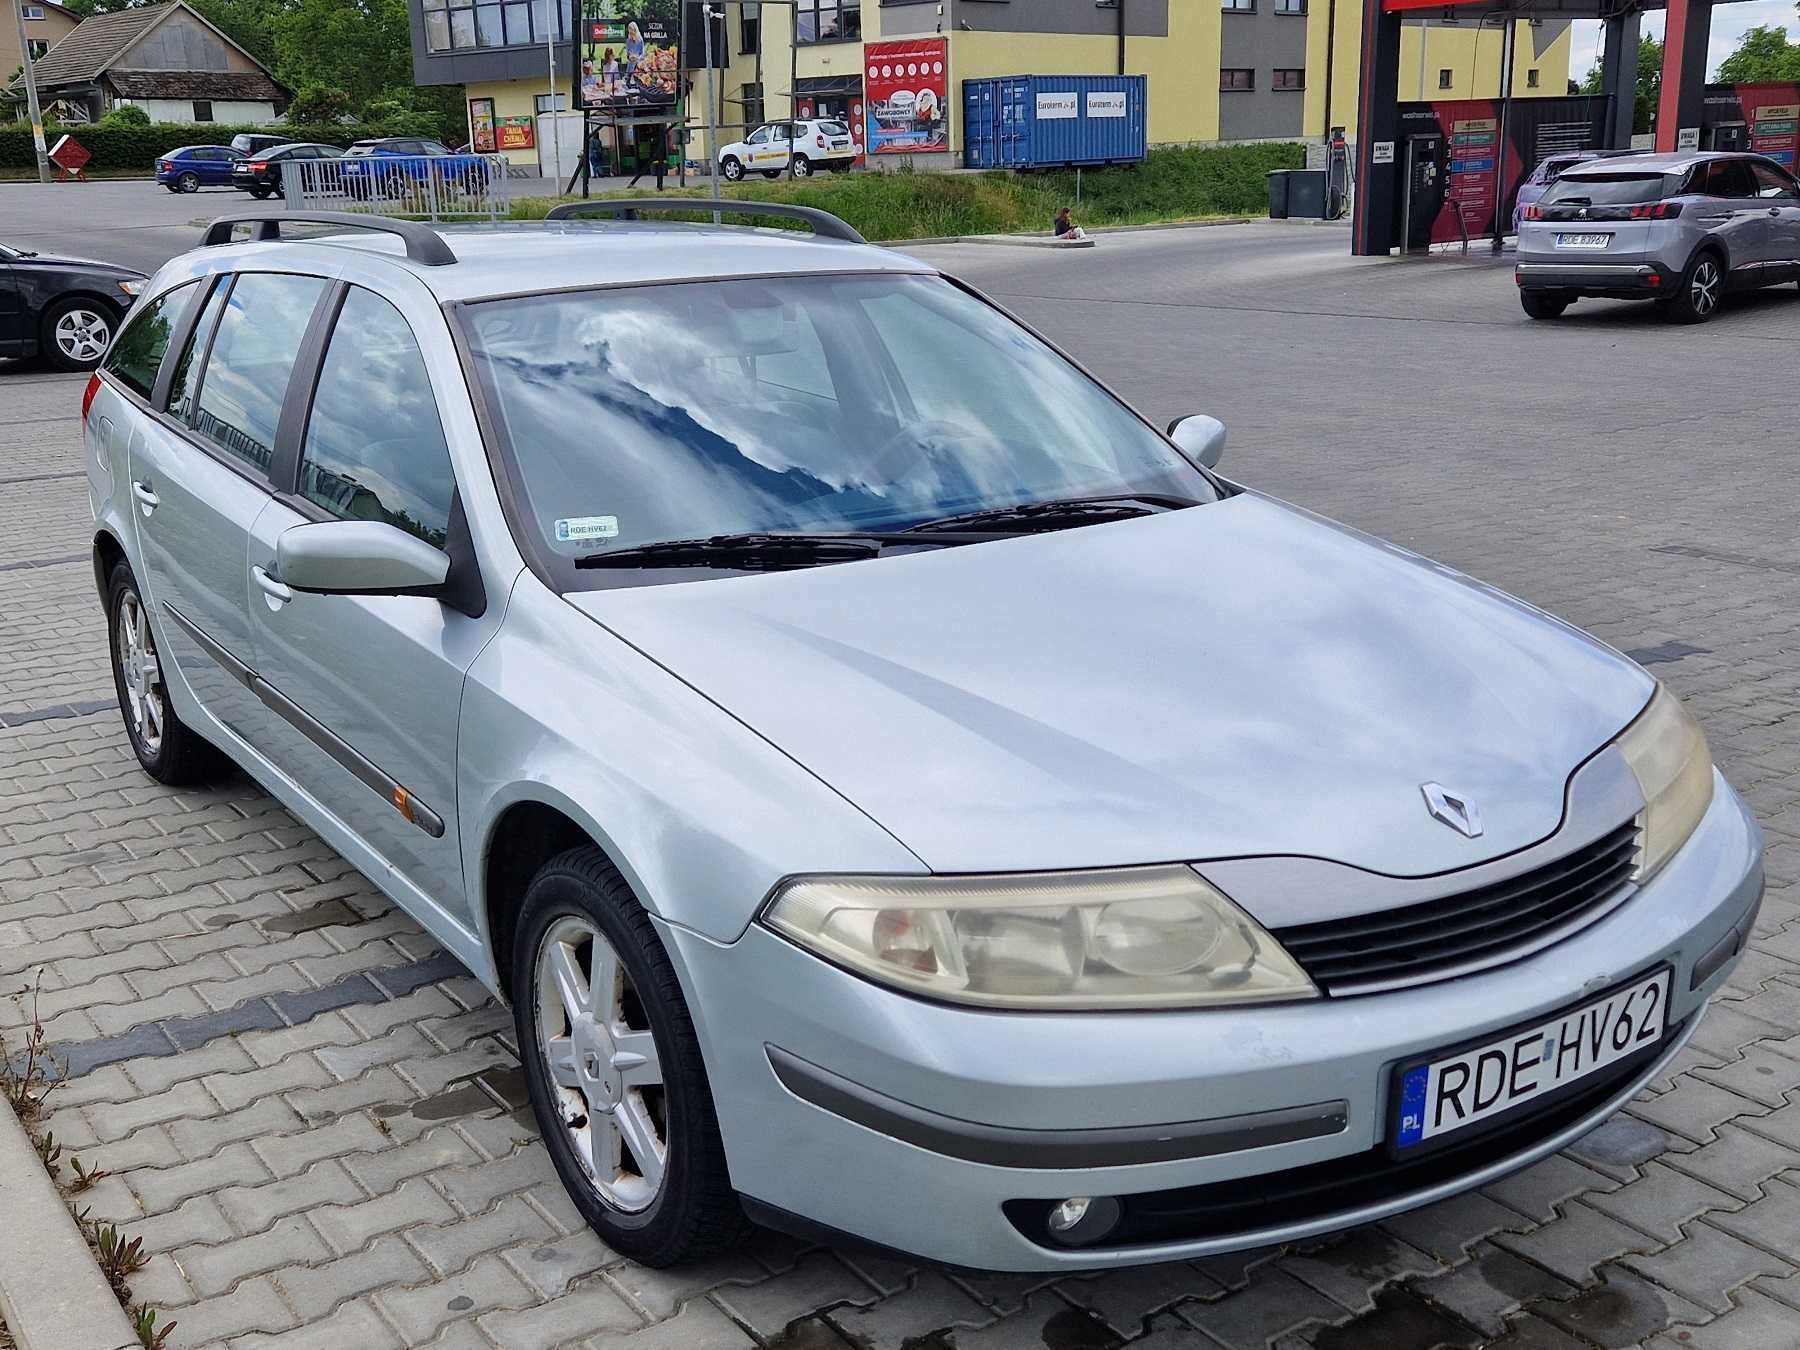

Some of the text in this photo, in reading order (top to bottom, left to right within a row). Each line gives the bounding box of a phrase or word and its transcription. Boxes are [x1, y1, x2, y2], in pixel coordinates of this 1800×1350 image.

[648, 22, 663, 30] SEZON
[504, 134, 526, 144] CHEMIA
[1563, 235, 1580, 244] RDE
[1434, 982, 1660, 1129] RDE HV62
[1402, 1113, 1420, 1134] PL
